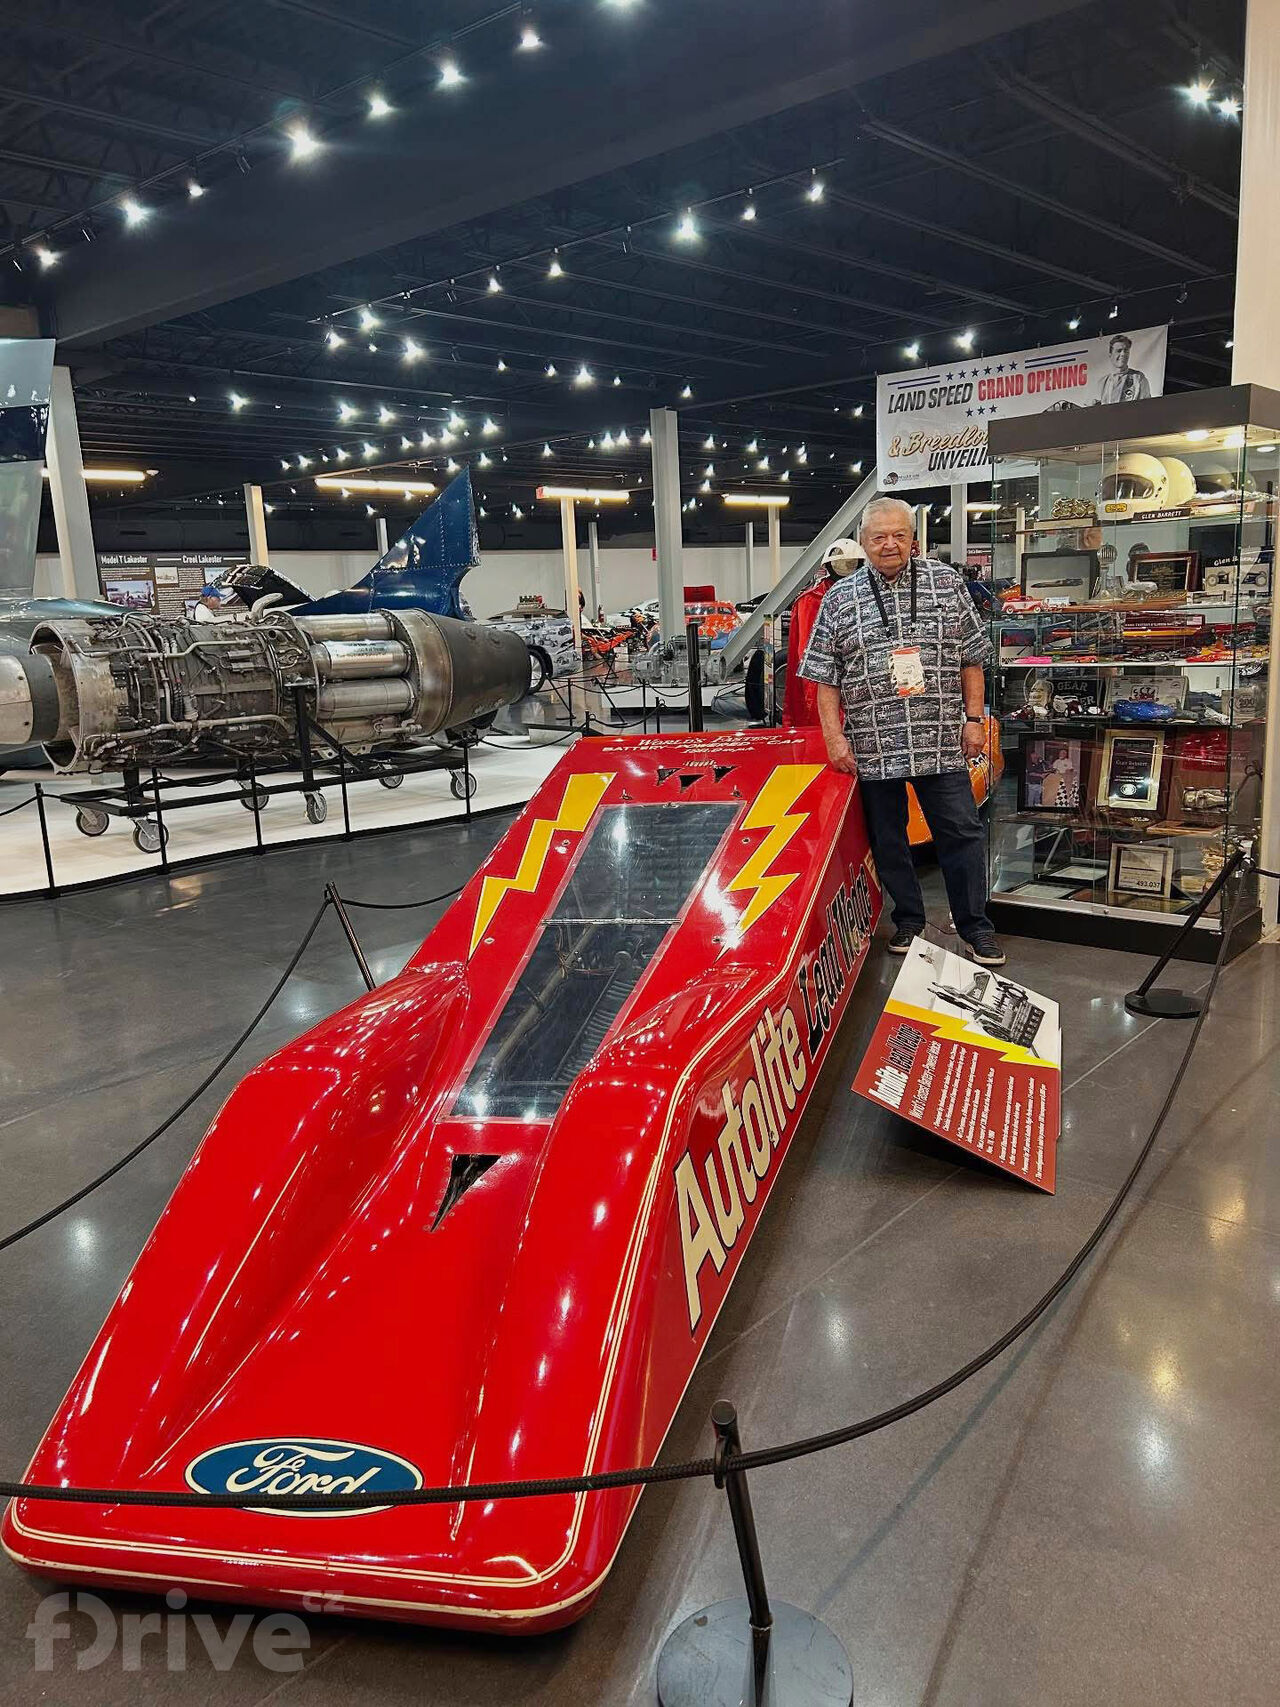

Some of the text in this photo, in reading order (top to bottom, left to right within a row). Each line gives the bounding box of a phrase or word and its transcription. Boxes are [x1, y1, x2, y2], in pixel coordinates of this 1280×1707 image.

[888, 363, 1088, 414] LAND SPEED GRAND OPENING
[888, 436, 902, 457] &
[101, 555, 119, 564] Model
[1057, 681, 1088, 691] GEAR
[868, 1066, 909, 1109] Autolite
[674, 1006, 806, 1336] Autolite
[226, 1445, 381, 1494] Ford
